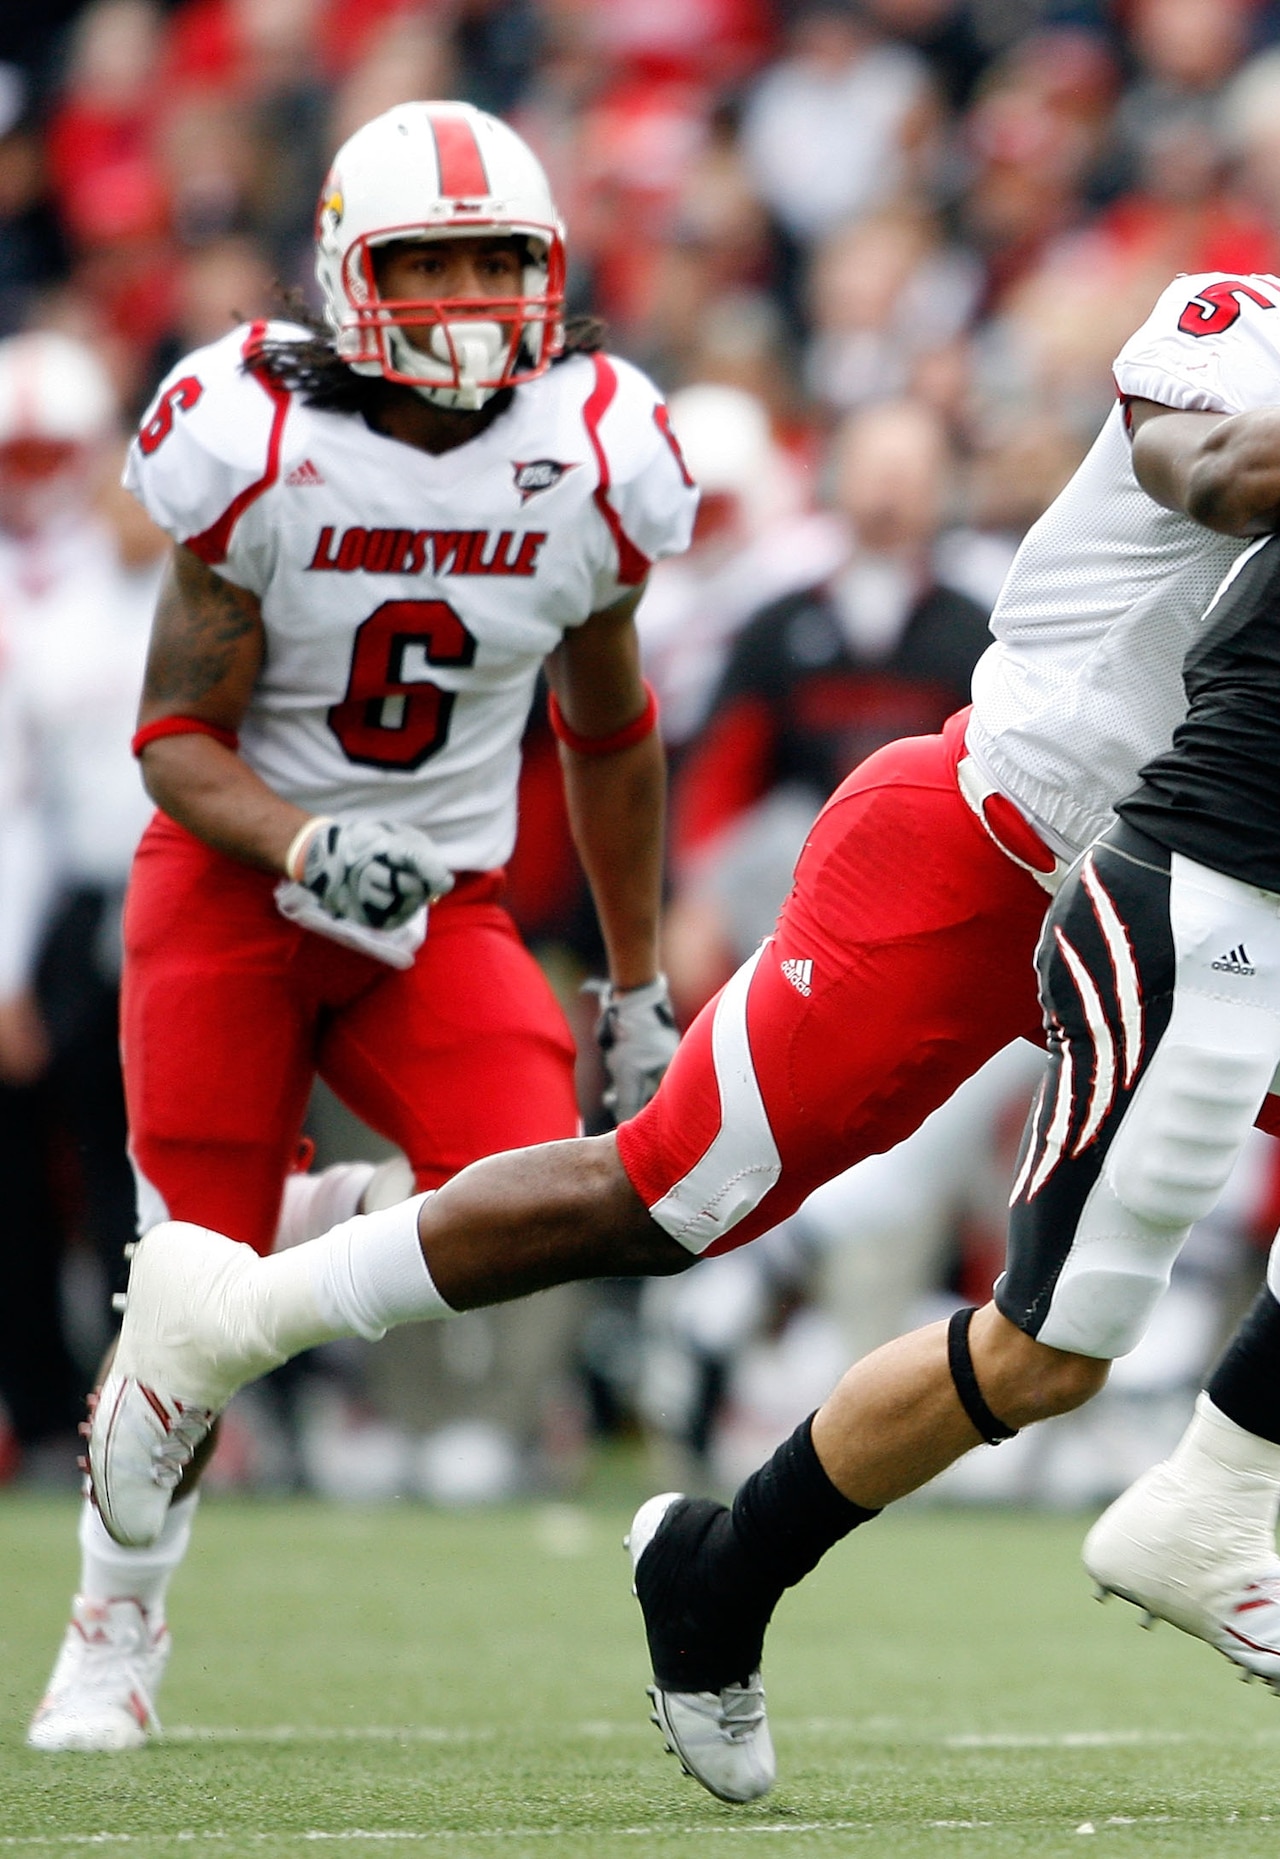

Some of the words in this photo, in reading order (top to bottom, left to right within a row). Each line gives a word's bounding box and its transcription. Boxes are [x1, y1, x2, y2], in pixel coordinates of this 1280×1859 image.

[1177, 281, 1277, 338] 5
[138, 373, 205, 459] 6
[304, 525, 549, 577] LOUISVILLE
[326, 598, 479, 774] 6
[780, 960, 813, 998] adidas
[1211, 960, 1256, 977] adidas
